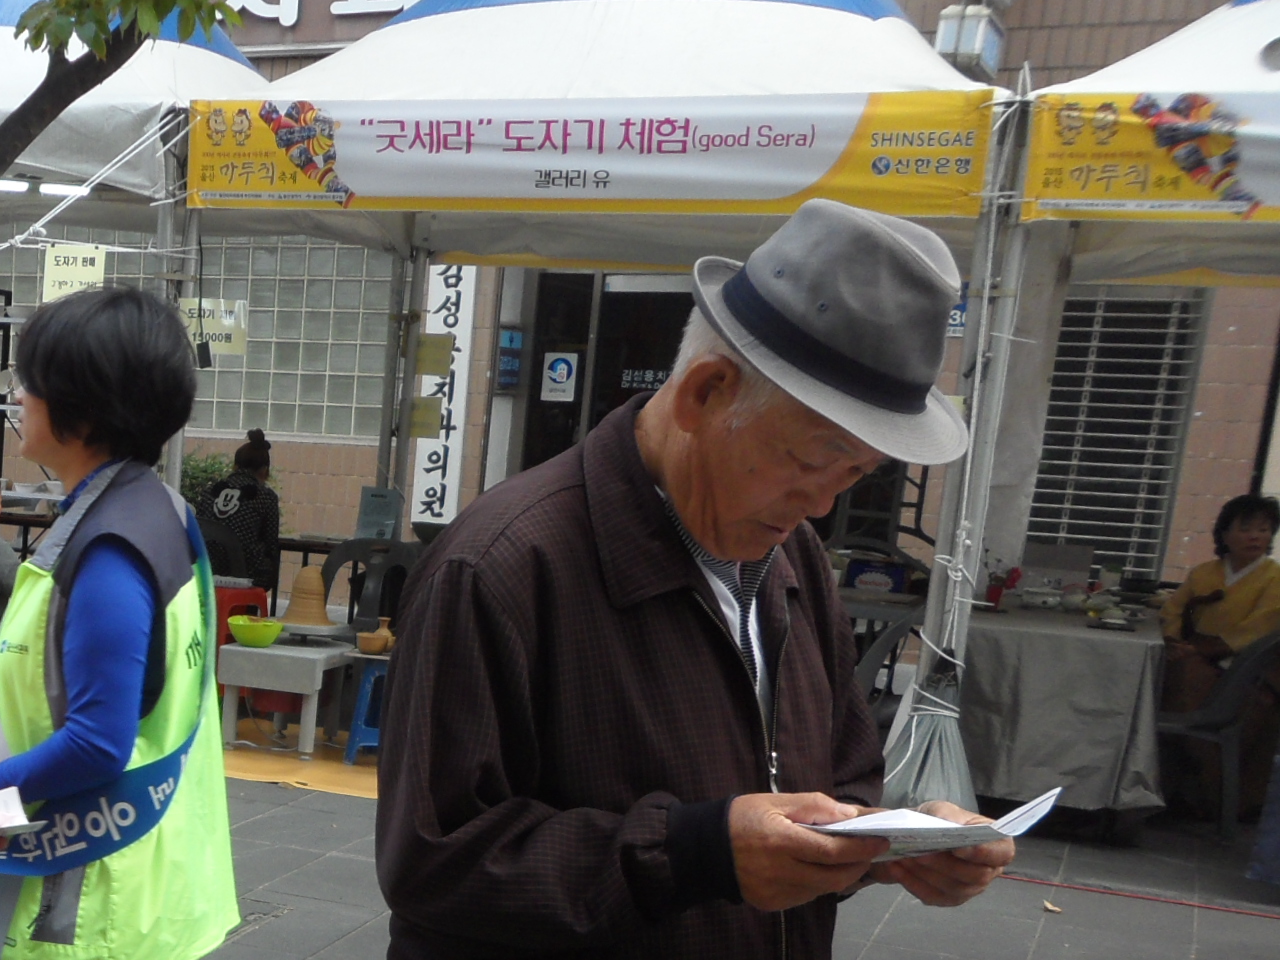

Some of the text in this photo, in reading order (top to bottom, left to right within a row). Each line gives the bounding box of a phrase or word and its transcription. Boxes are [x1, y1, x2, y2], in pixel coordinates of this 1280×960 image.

[502, 118, 606, 155] 도자기
[870, 129, 975, 149] SHINSEGAE
[892, 156, 972, 176] 신한은행
[534, 168, 612, 190] 갤러리 유
[53, 255, 96, 268] 도자기 판매
[622, 368, 672, 382] 김성용치
[418, 264, 463, 518] 김성치의원
